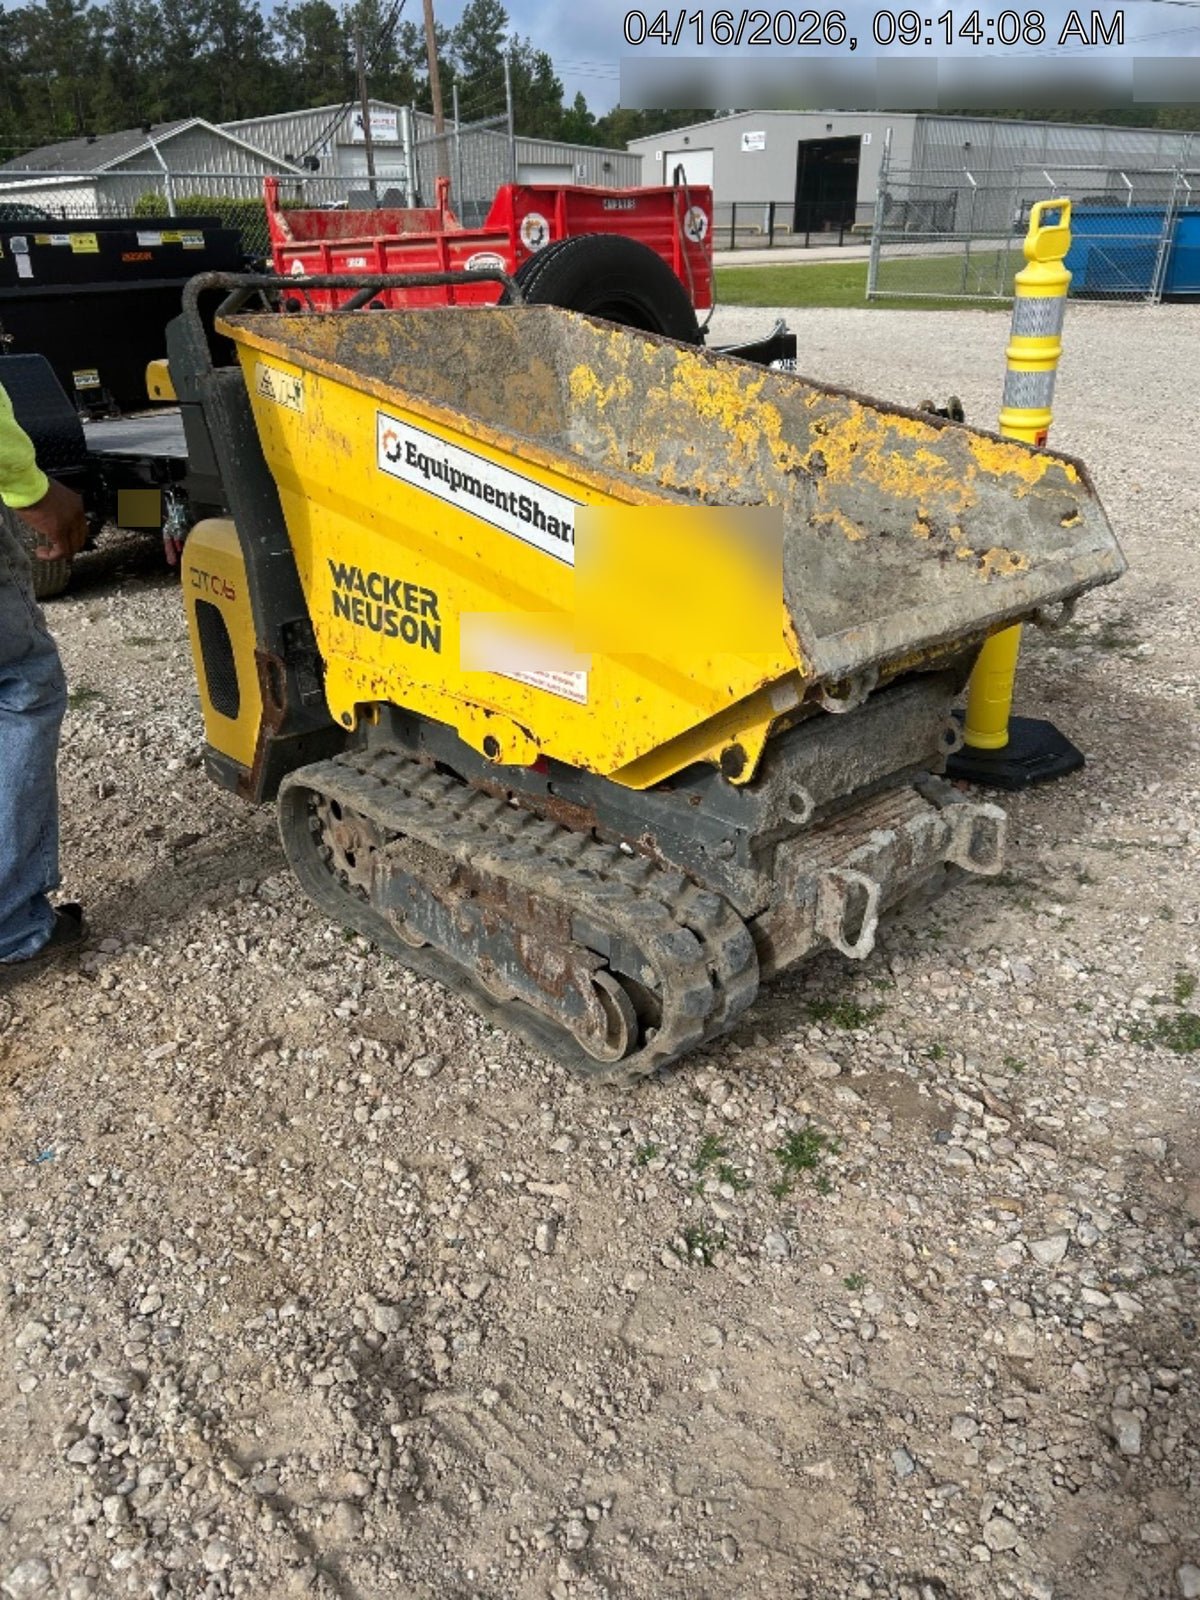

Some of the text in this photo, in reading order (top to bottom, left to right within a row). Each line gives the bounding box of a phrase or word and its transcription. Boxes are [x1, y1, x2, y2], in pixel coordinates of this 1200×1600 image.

[404, 440, 575, 546] EquipmentShar
[326, 558, 441, 623] WACKER
[332, 590, 441, 654] NEUSON
